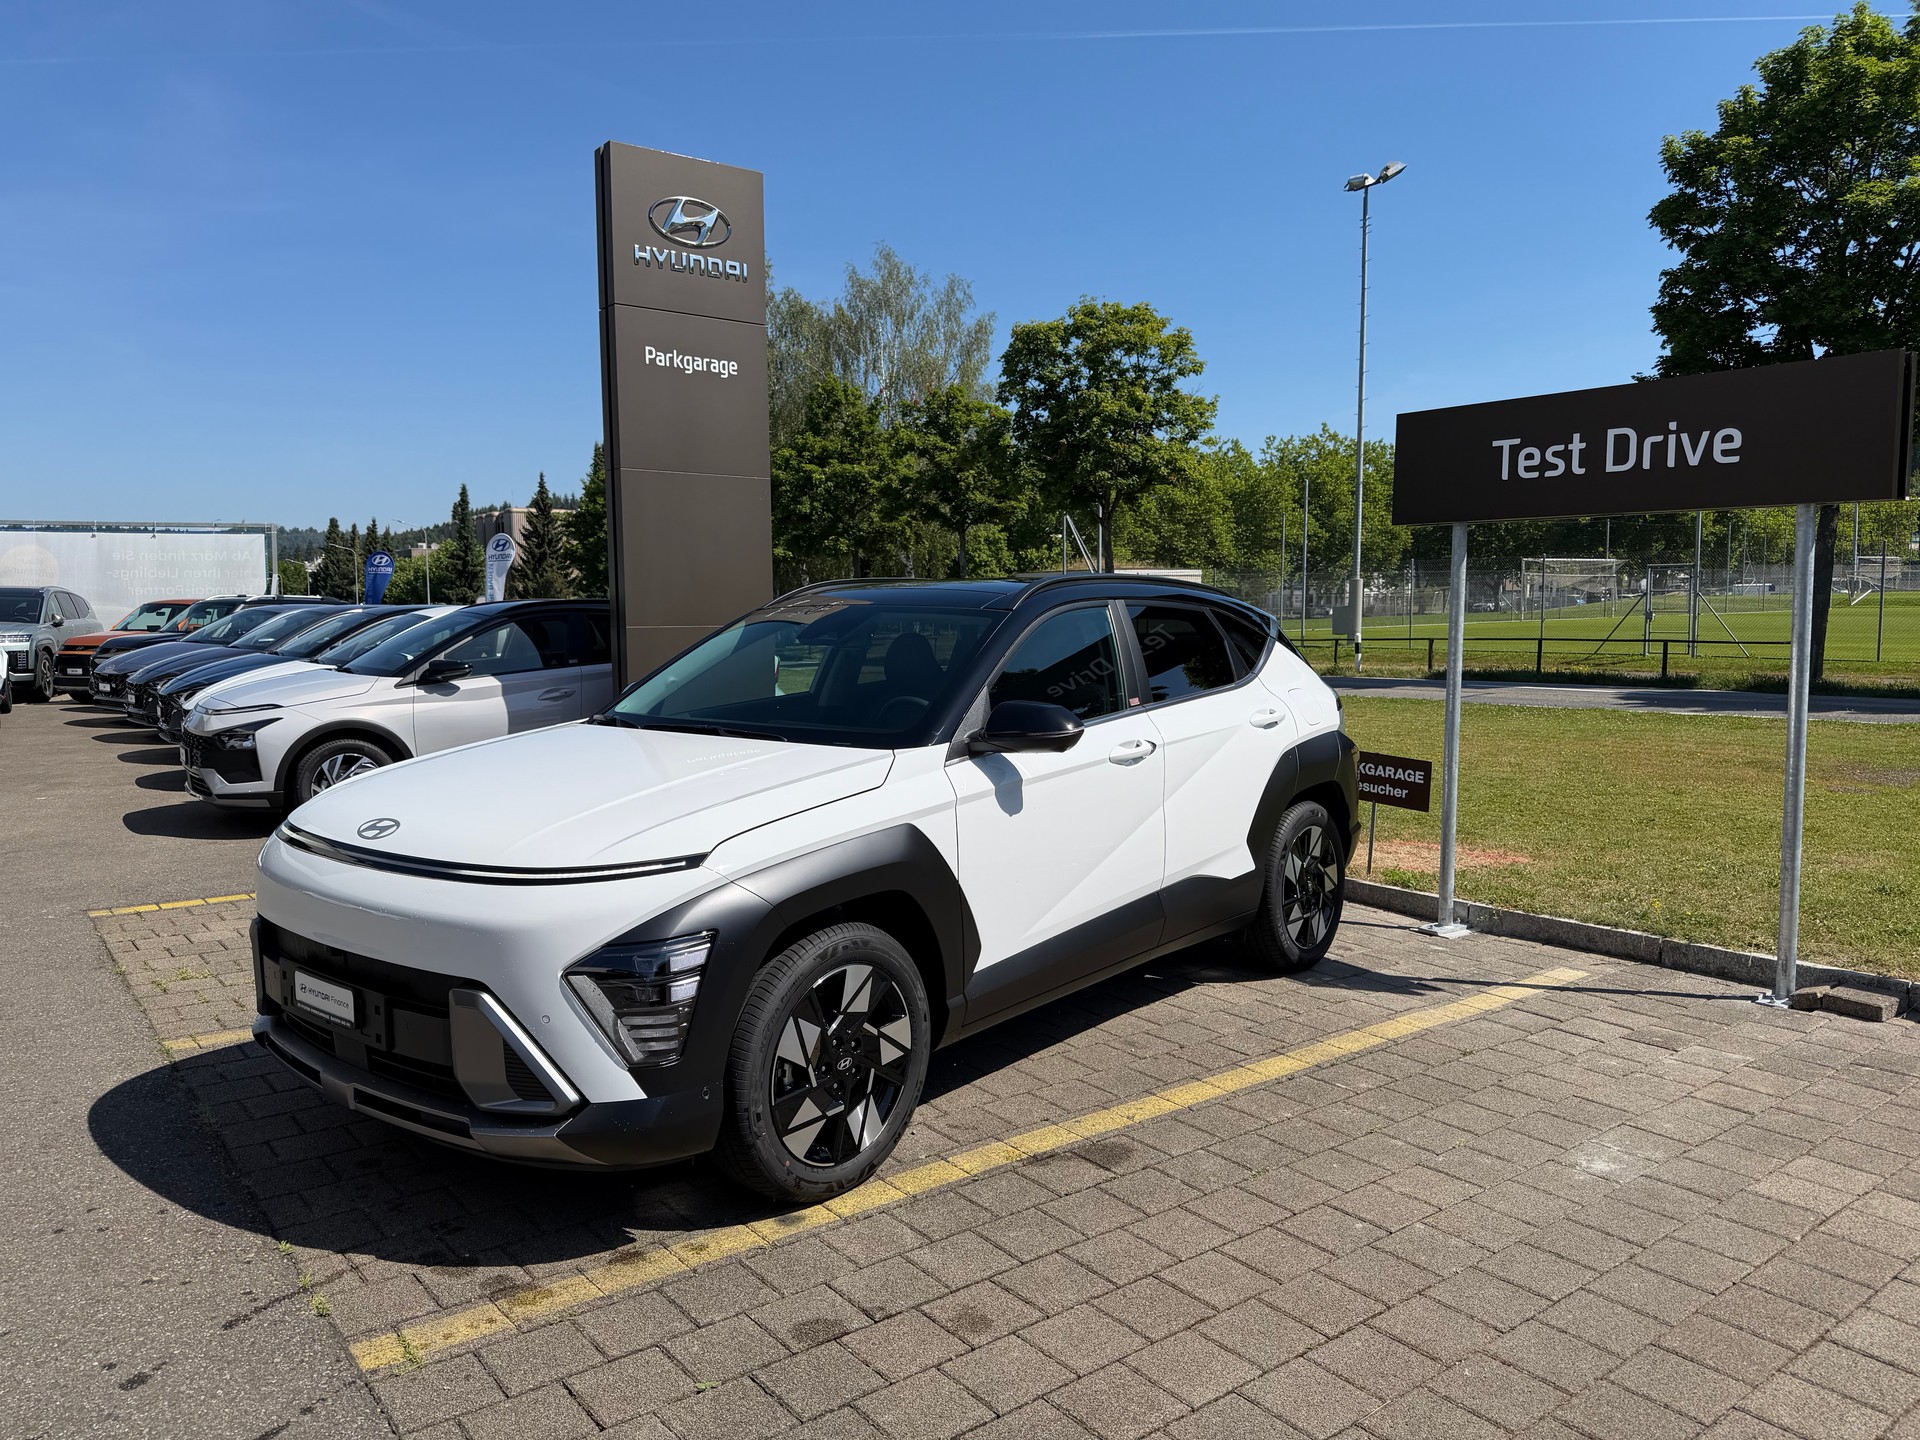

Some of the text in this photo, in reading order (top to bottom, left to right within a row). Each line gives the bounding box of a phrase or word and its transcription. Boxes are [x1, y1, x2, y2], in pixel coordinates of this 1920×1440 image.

[634, 244, 748, 283] HYUNDAI
[644, 346, 738, 378] Parkgarage
[1492, 421, 1743, 481] Test Drive
[1359, 762, 1425, 784] KGARAGE
[308, 987, 350, 1010] HYUNDAI Finance
